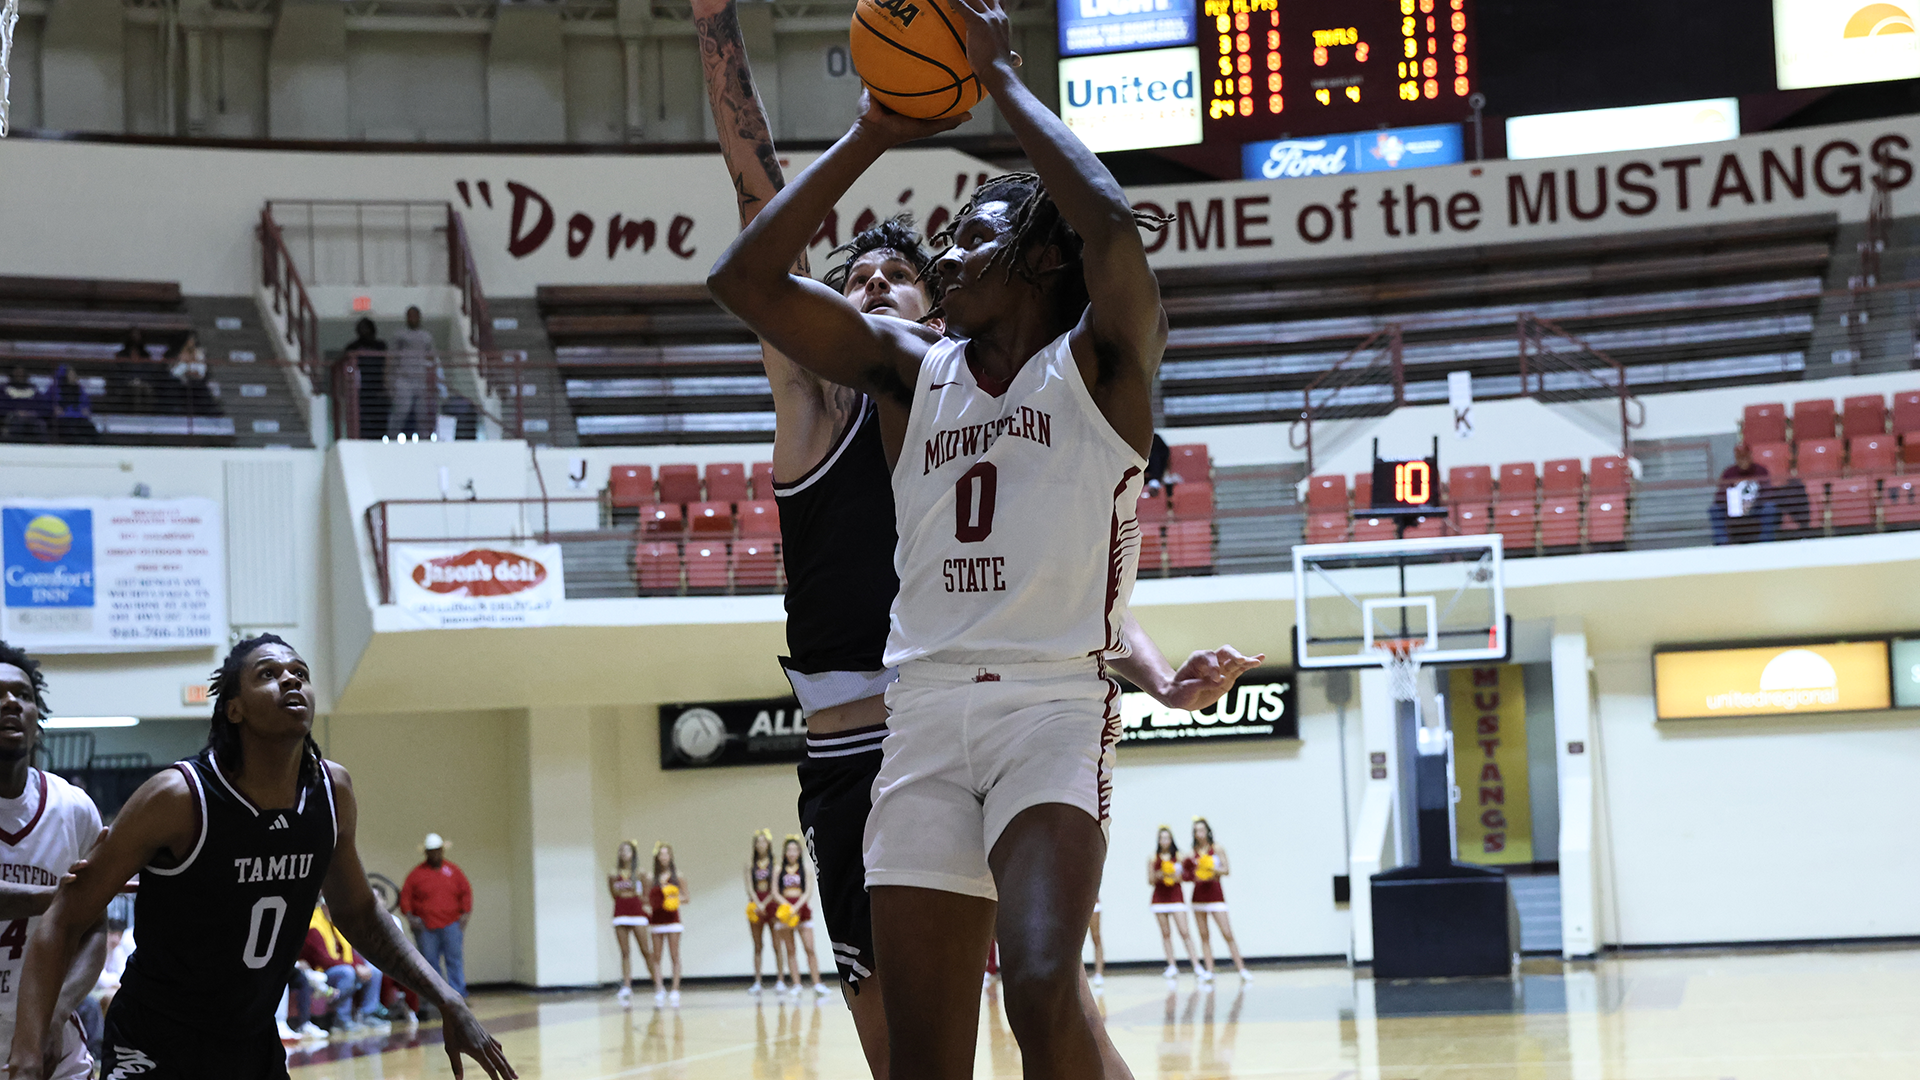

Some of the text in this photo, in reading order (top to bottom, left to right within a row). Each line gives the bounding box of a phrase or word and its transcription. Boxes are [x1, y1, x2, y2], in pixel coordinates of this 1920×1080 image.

[1067, 71, 1193, 107] United
[1262, 140, 1348, 179] Ford
[1136, 133, 1914, 255] OME of the MUSTANGS
[1454, 407, 1472, 430] K
[923, 405, 1051, 476] MIDWEERN
[570, 460, 586, 481] J
[1395, 461, 1430, 504] 10
[955, 461, 997, 543] 0
[5, 565, 94, 588] Comfort
[420, 559, 536, 588] Jason's deli
[943, 556, 1006, 592] STATE
[1473, 667, 1506, 853] MUSTANGS
[235, 853, 314, 883] TAMIU
[243, 896, 287, 969] 0
